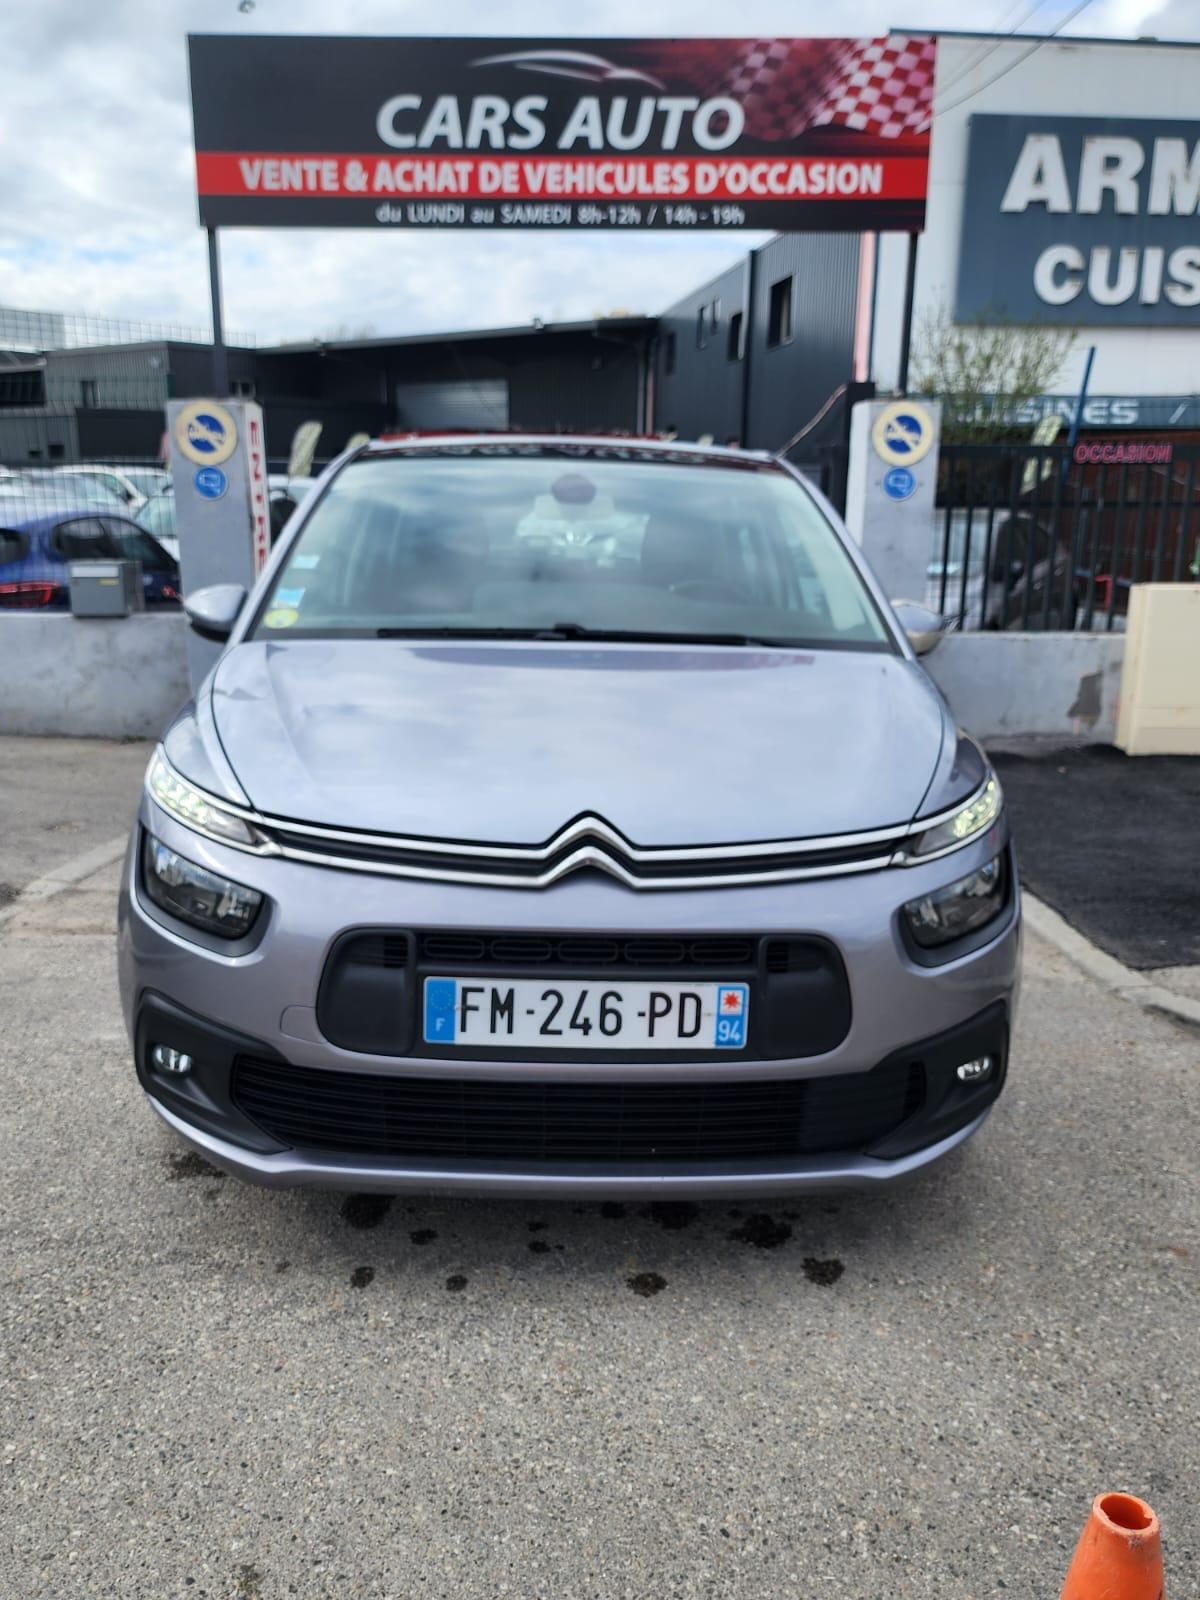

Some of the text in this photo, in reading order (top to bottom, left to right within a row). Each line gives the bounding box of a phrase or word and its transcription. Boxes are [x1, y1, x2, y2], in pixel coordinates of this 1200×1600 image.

[376, 94, 746, 151] CARS AUTO
[239, 159, 883, 195] VENTE & ACHAT DE VEHICULES D'OCCASION
[1000, 134, 1200, 216] ARM
[375, 203, 402, 223] du
[407, 204, 466, 224] LUNDI
[470, 208, 495, 224] au
[500, 204, 572, 225] SAMEDI
[576, 205, 642, 225] 8h-12h
[1033, 245, 1200, 306] CUIS
[1073, 443, 1173, 464] OCCASION
[434, 1017, 446, 1032] F
[718, 1019, 741, 1043] 94
